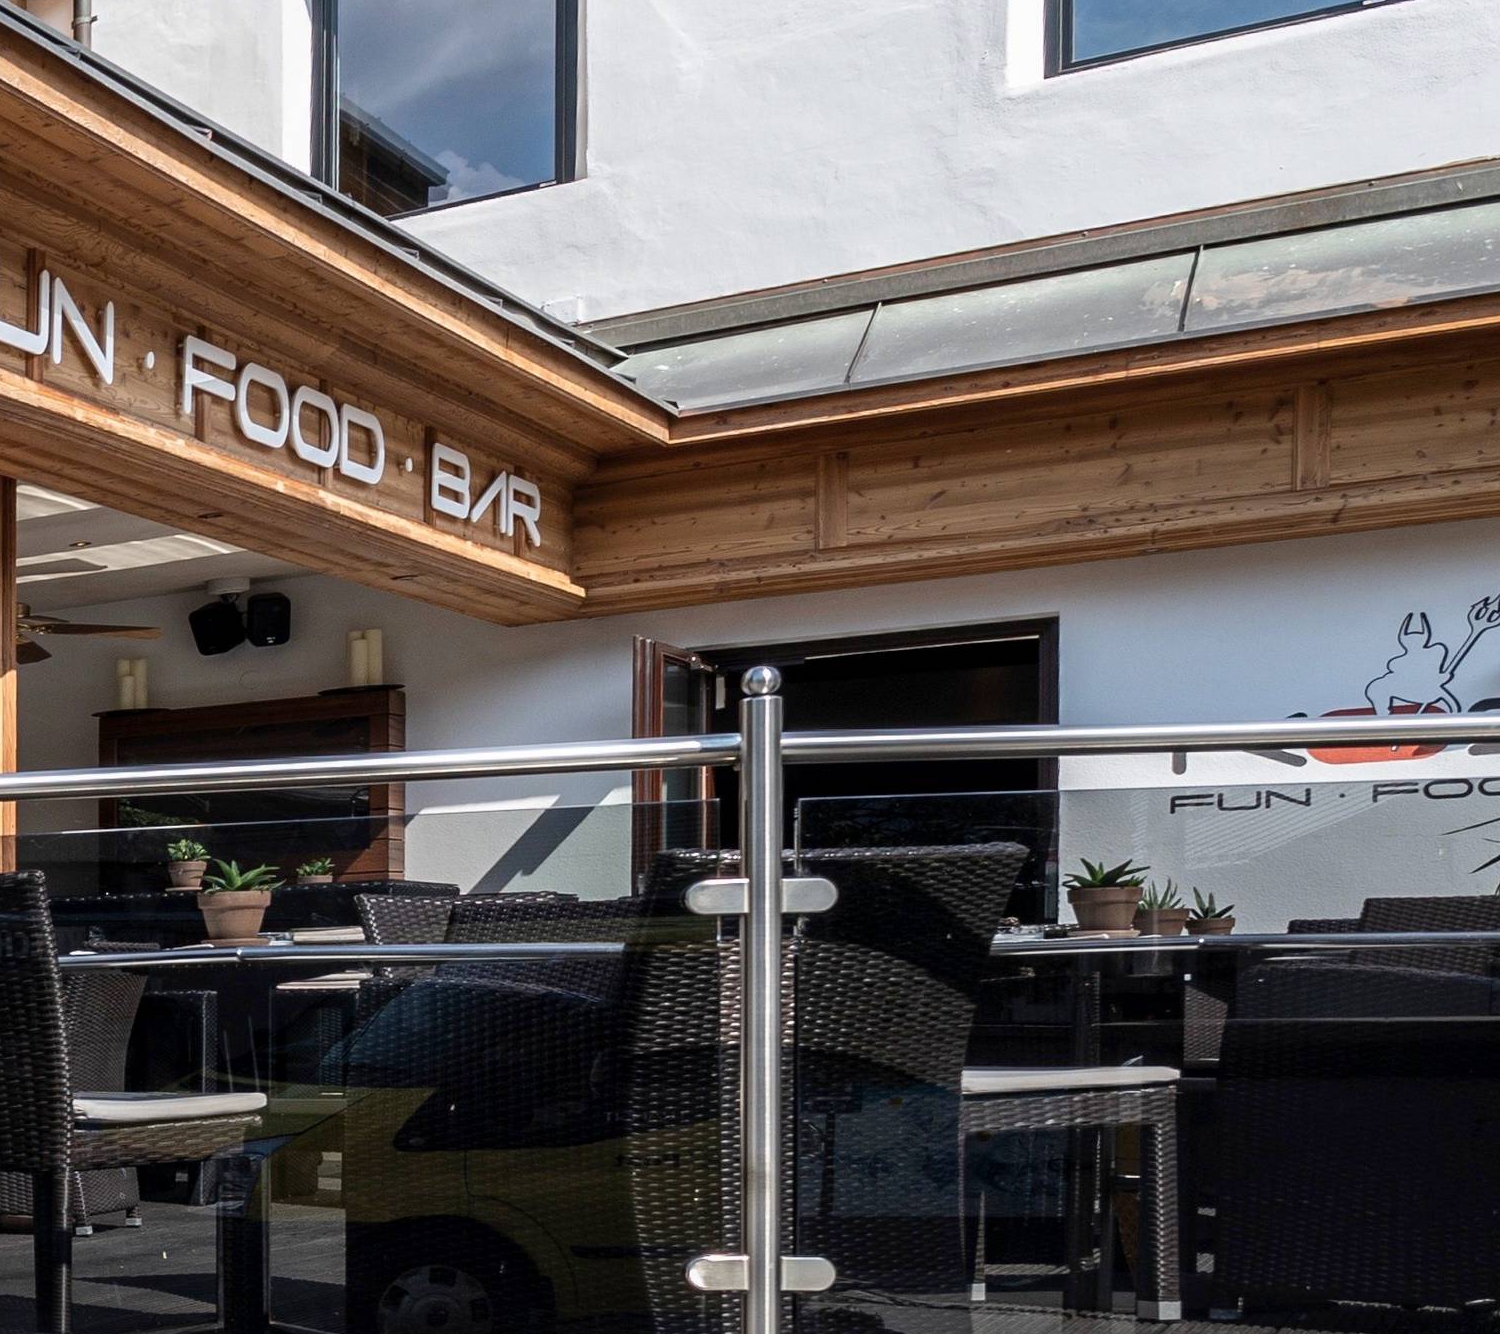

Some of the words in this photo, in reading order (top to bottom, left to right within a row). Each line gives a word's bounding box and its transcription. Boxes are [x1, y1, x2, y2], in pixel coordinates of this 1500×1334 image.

[182, 335, 386, 486] FOOD
[430, 441, 542, 547] BAR
[1169, 788, 1311, 814] FUN
